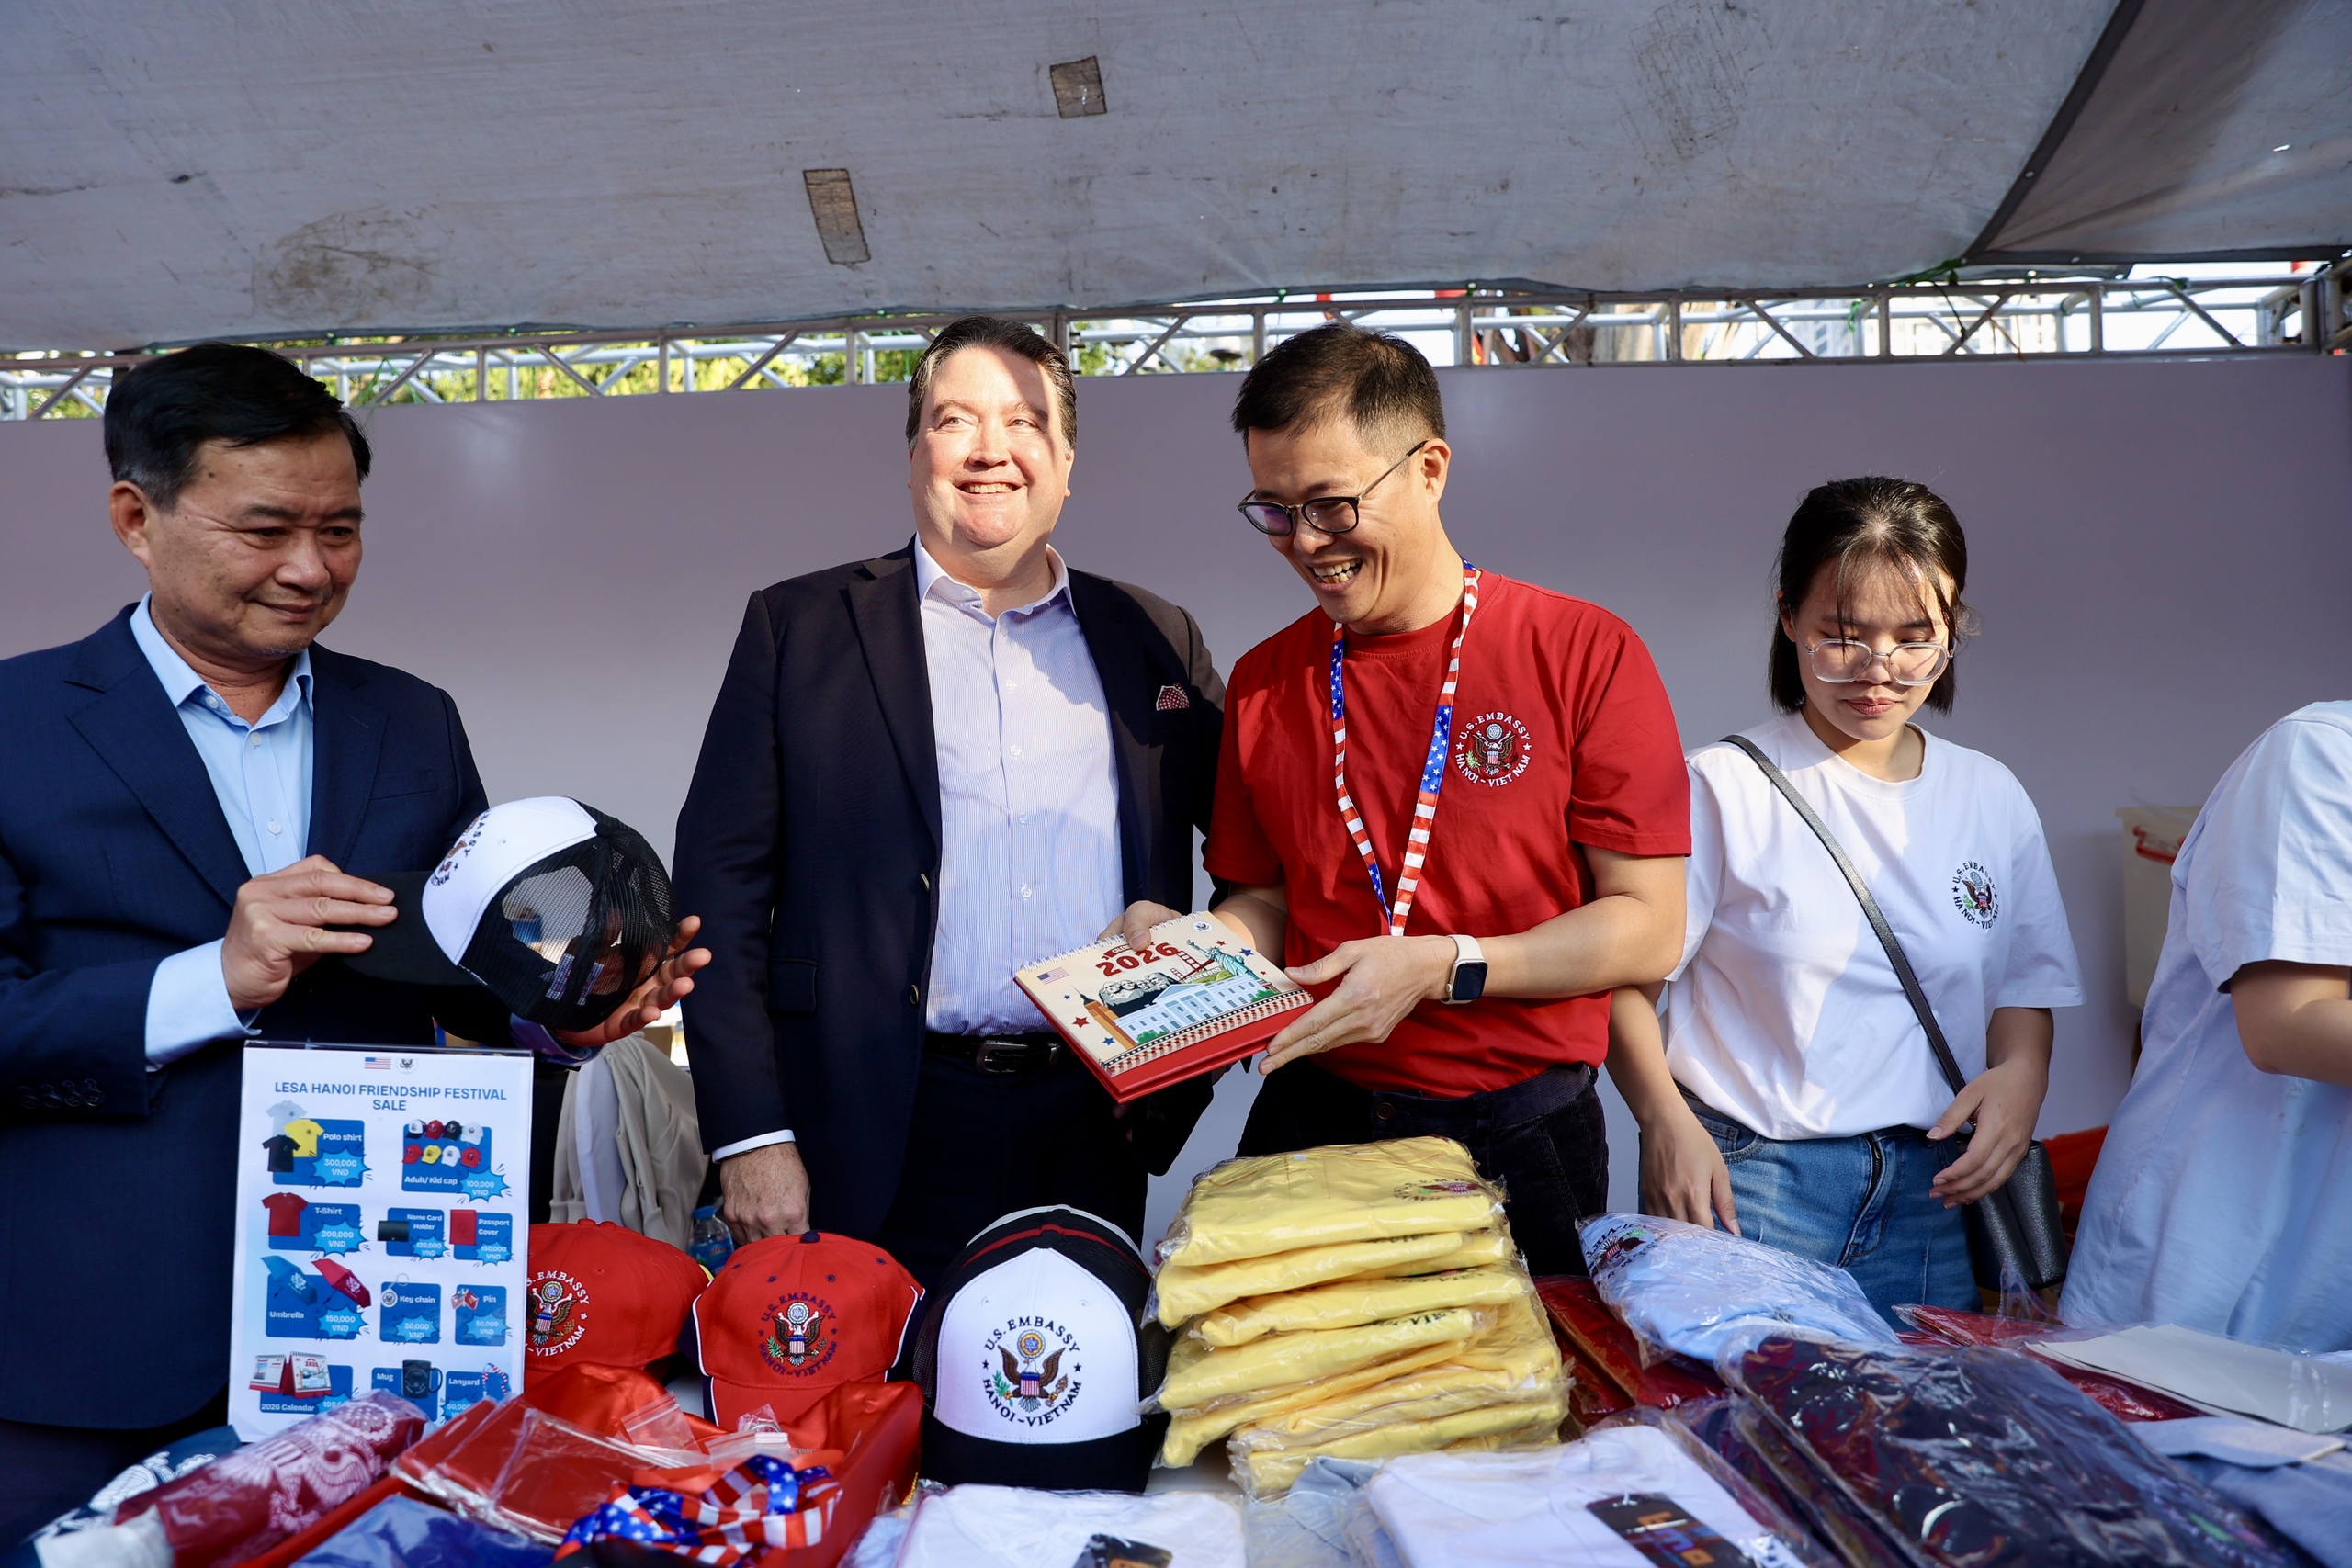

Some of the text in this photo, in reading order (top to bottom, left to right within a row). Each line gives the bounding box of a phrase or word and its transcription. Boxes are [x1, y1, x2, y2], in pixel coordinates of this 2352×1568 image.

[1095, 942, 1179, 977] 2026
[275, 1082, 507, 1100] LESA HANOI FRIENDSHIP FESTIVAL
[372, 1100, 407, 1111] SALE
[324, 1159, 356, 1168] 300,000
[404, 1176, 427, 1184] Adult/
[467, 1180, 494, 1189] 100,000
[315, 1207, 343, 1215] T-Shirt
[478, 1219, 510, 1227] Passport
[322, 1230, 354, 1239] 200,000
[537, 1270, 590, 1304] EMBASSY
[326, 1315, 356, 1324] 150,000
[1007, 1316, 1080, 1352] EMBASSY
[377, 1372, 394, 1382] Mug
[448, 1378, 480, 1386] Lanyard
[281, 1404, 315, 1412] Calendar
